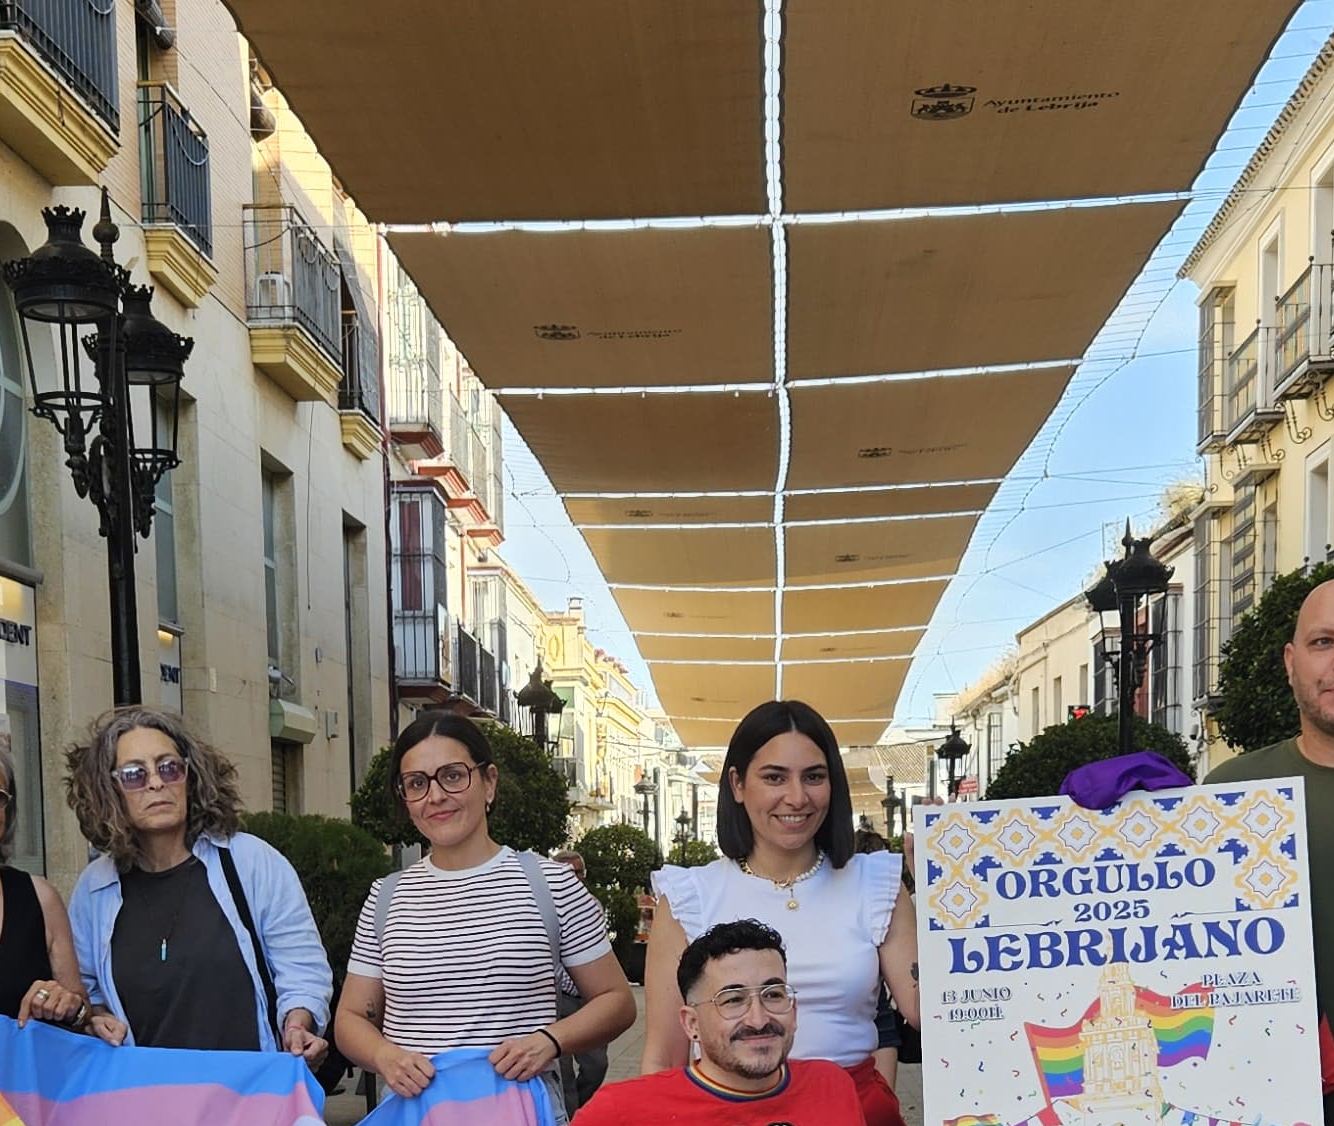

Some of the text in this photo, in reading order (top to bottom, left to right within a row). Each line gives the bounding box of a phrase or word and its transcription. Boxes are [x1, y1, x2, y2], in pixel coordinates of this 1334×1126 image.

[995, 857, 1216, 900] ORGULLO
[1073, 899, 1151, 923] 2025
[948, 916, 1286, 974] LEBRIJANO
[960, 986, 1012, 1003] JUNIO
